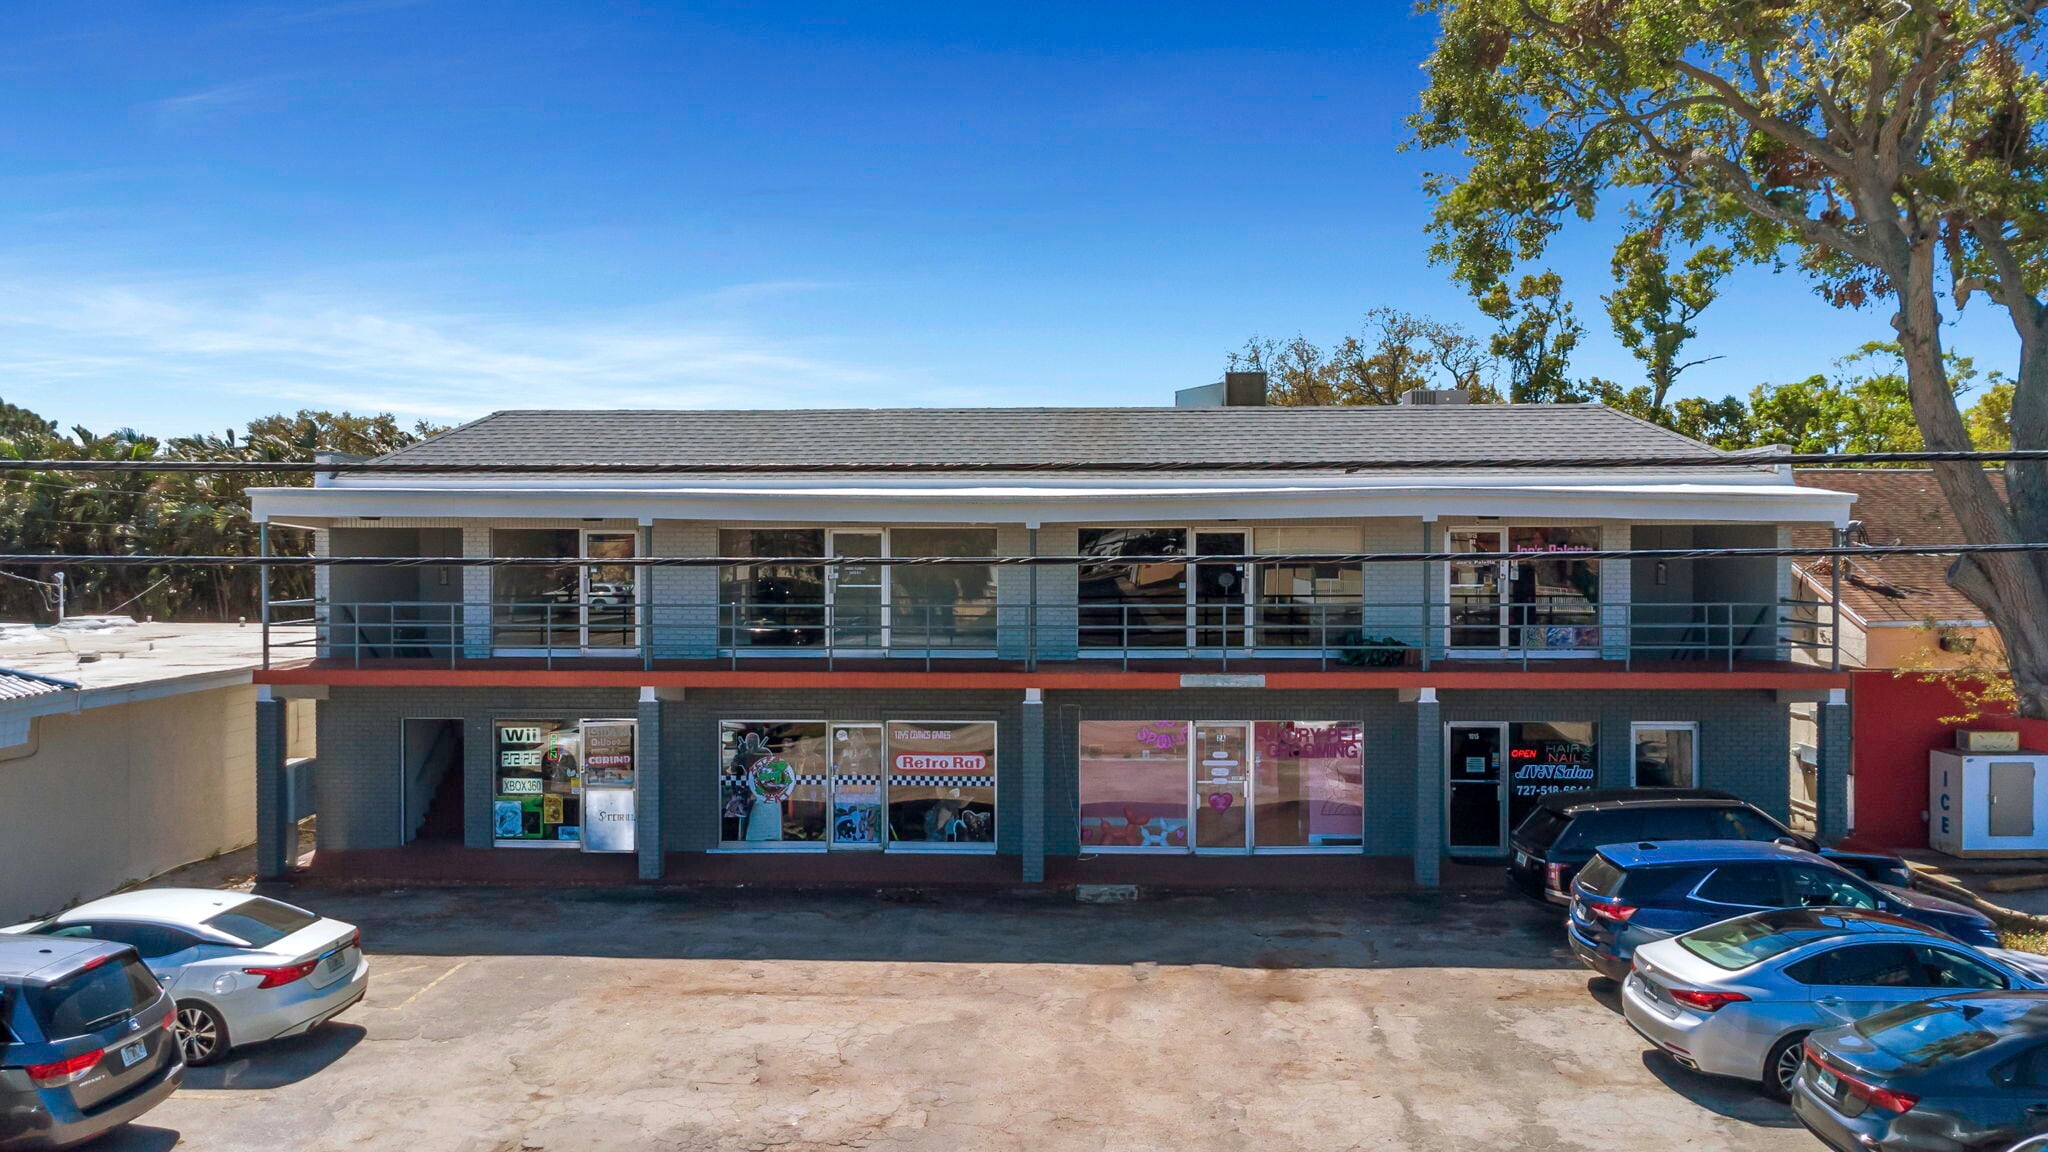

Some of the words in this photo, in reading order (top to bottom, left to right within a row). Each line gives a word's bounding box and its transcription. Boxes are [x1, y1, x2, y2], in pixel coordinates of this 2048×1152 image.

[505, 729, 537, 741] Wii
[1328, 727, 1361, 742] PET
[1268, 744, 1358, 758] GROOMING
[1511, 749, 1537, 758] OPEN
[1546, 744, 1580, 752] HAIR
[903, 756, 949, 768] Retro
[952, 756, 982, 768] Rat
[1548, 754, 1591, 763] NAILS
[1555, 765, 1594, 779] Salon
[504, 780, 527, 792] XBOX
[528, 780, 542, 792] 360
[1940, 770, 1950, 834] ICE
